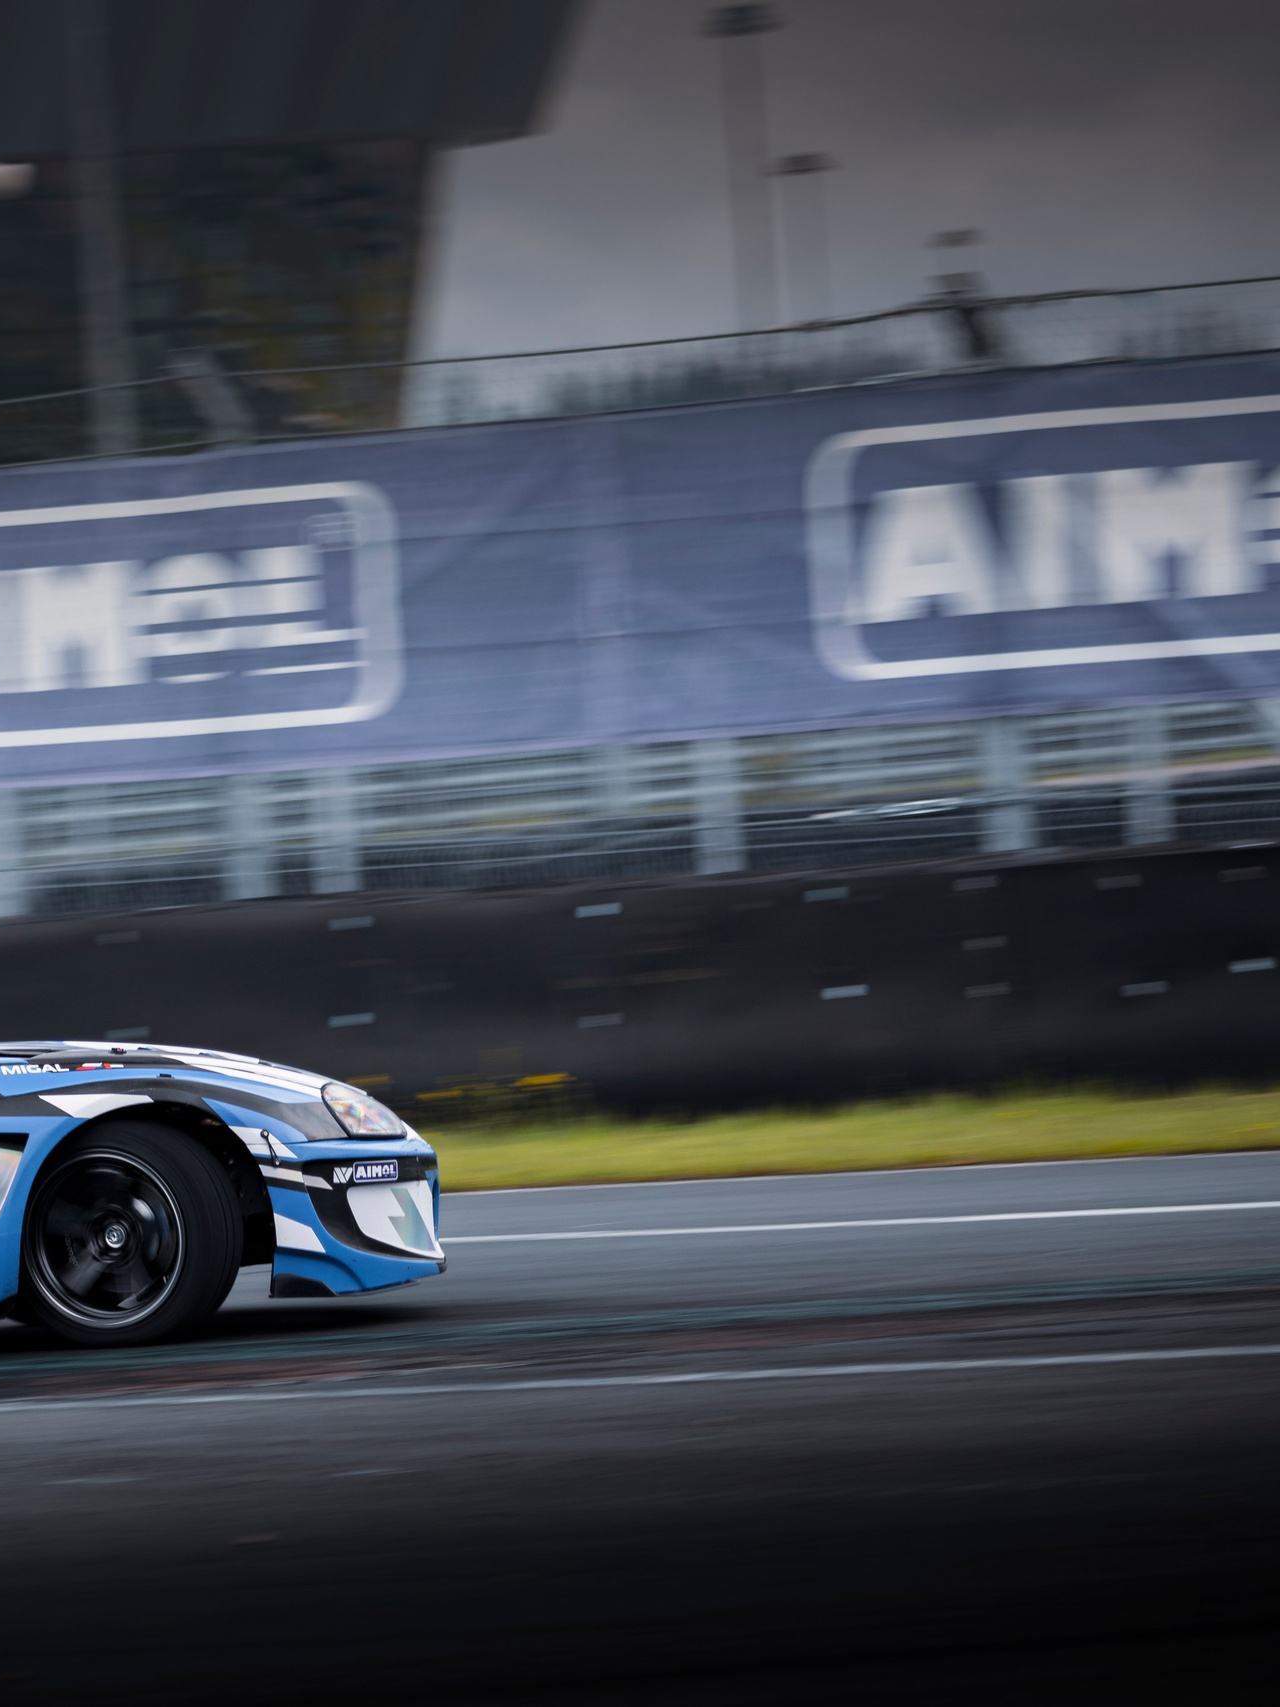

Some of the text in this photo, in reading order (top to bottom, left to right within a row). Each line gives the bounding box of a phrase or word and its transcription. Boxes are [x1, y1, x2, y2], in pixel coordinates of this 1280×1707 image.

[846, 460, 1280, 625] AIM
[2, 1063, 70, 1076] MIGAL
[355, 1164, 396, 1178] AIMOL
